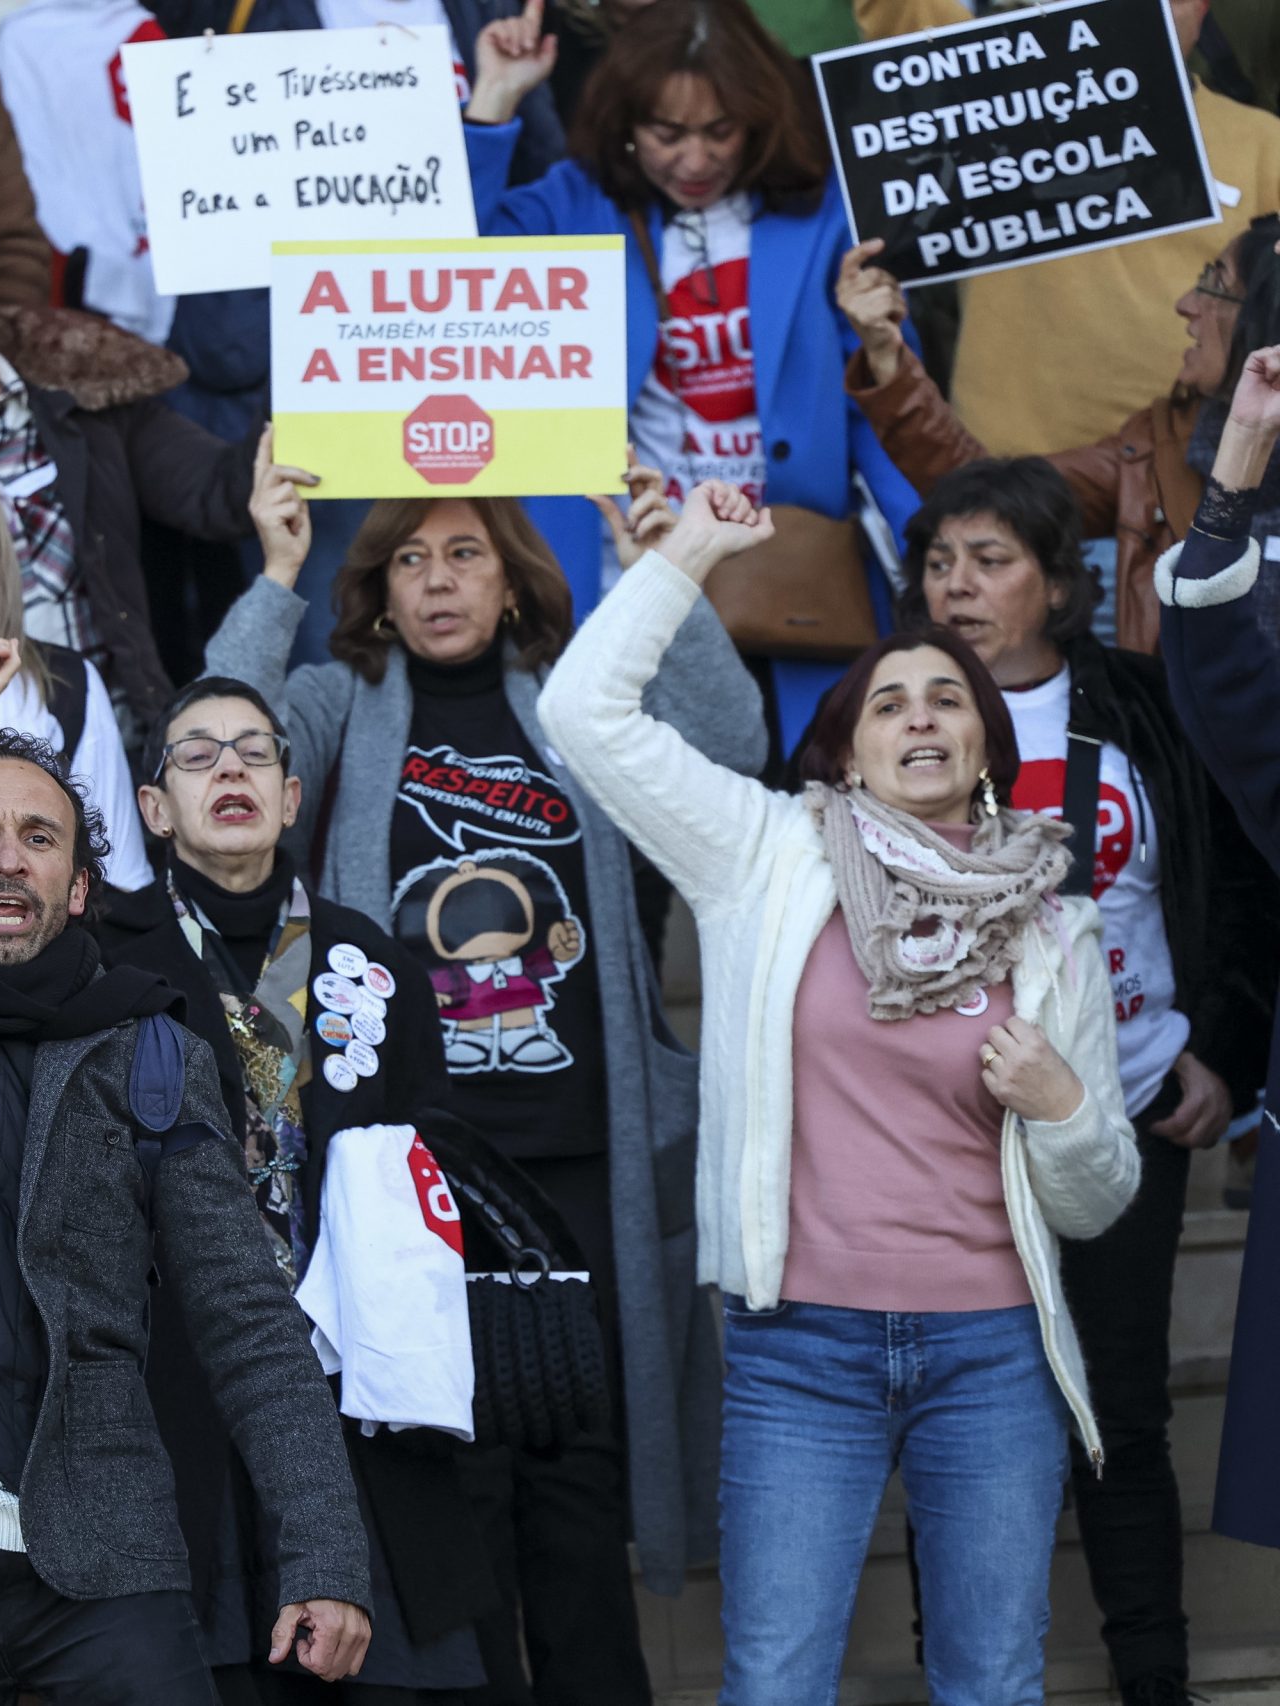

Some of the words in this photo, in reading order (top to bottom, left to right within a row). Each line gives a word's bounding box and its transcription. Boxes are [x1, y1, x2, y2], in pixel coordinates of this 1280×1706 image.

[872, 30, 1047, 93] CONTRA
[1068, 19, 1100, 53] A
[176, 71, 195, 118] E
[226, 82, 257, 107] se
[851, 67, 1139, 158] DESTRUIÇÃO
[233, 132, 279, 155] um
[295, 120, 366, 150] Palco
[256, 193, 269, 207] a
[295, 156, 441, 215] EDUCAÇÃO?
[882, 173, 950, 217] DA
[957, 125, 1158, 200] ESCOLA
[917, 186, 1153, 267] PÚBLICA
[299, 270, 351, 314] A
[372, 267, 589, 313] LUTAR
[337, 320, 436, 340] TAMBÉM
[443, 320, 551, 339] ESTAMOS
[301, 348, 341, 382] A
[358, 344, 593, 381] ENSINAR
[403, 757, 568, 823] RESPEITO
[403, 781, 494, 816] PROFESSORES
[494, 808, 517, 824] EM
[516, 814, 552, 837] LUTA
